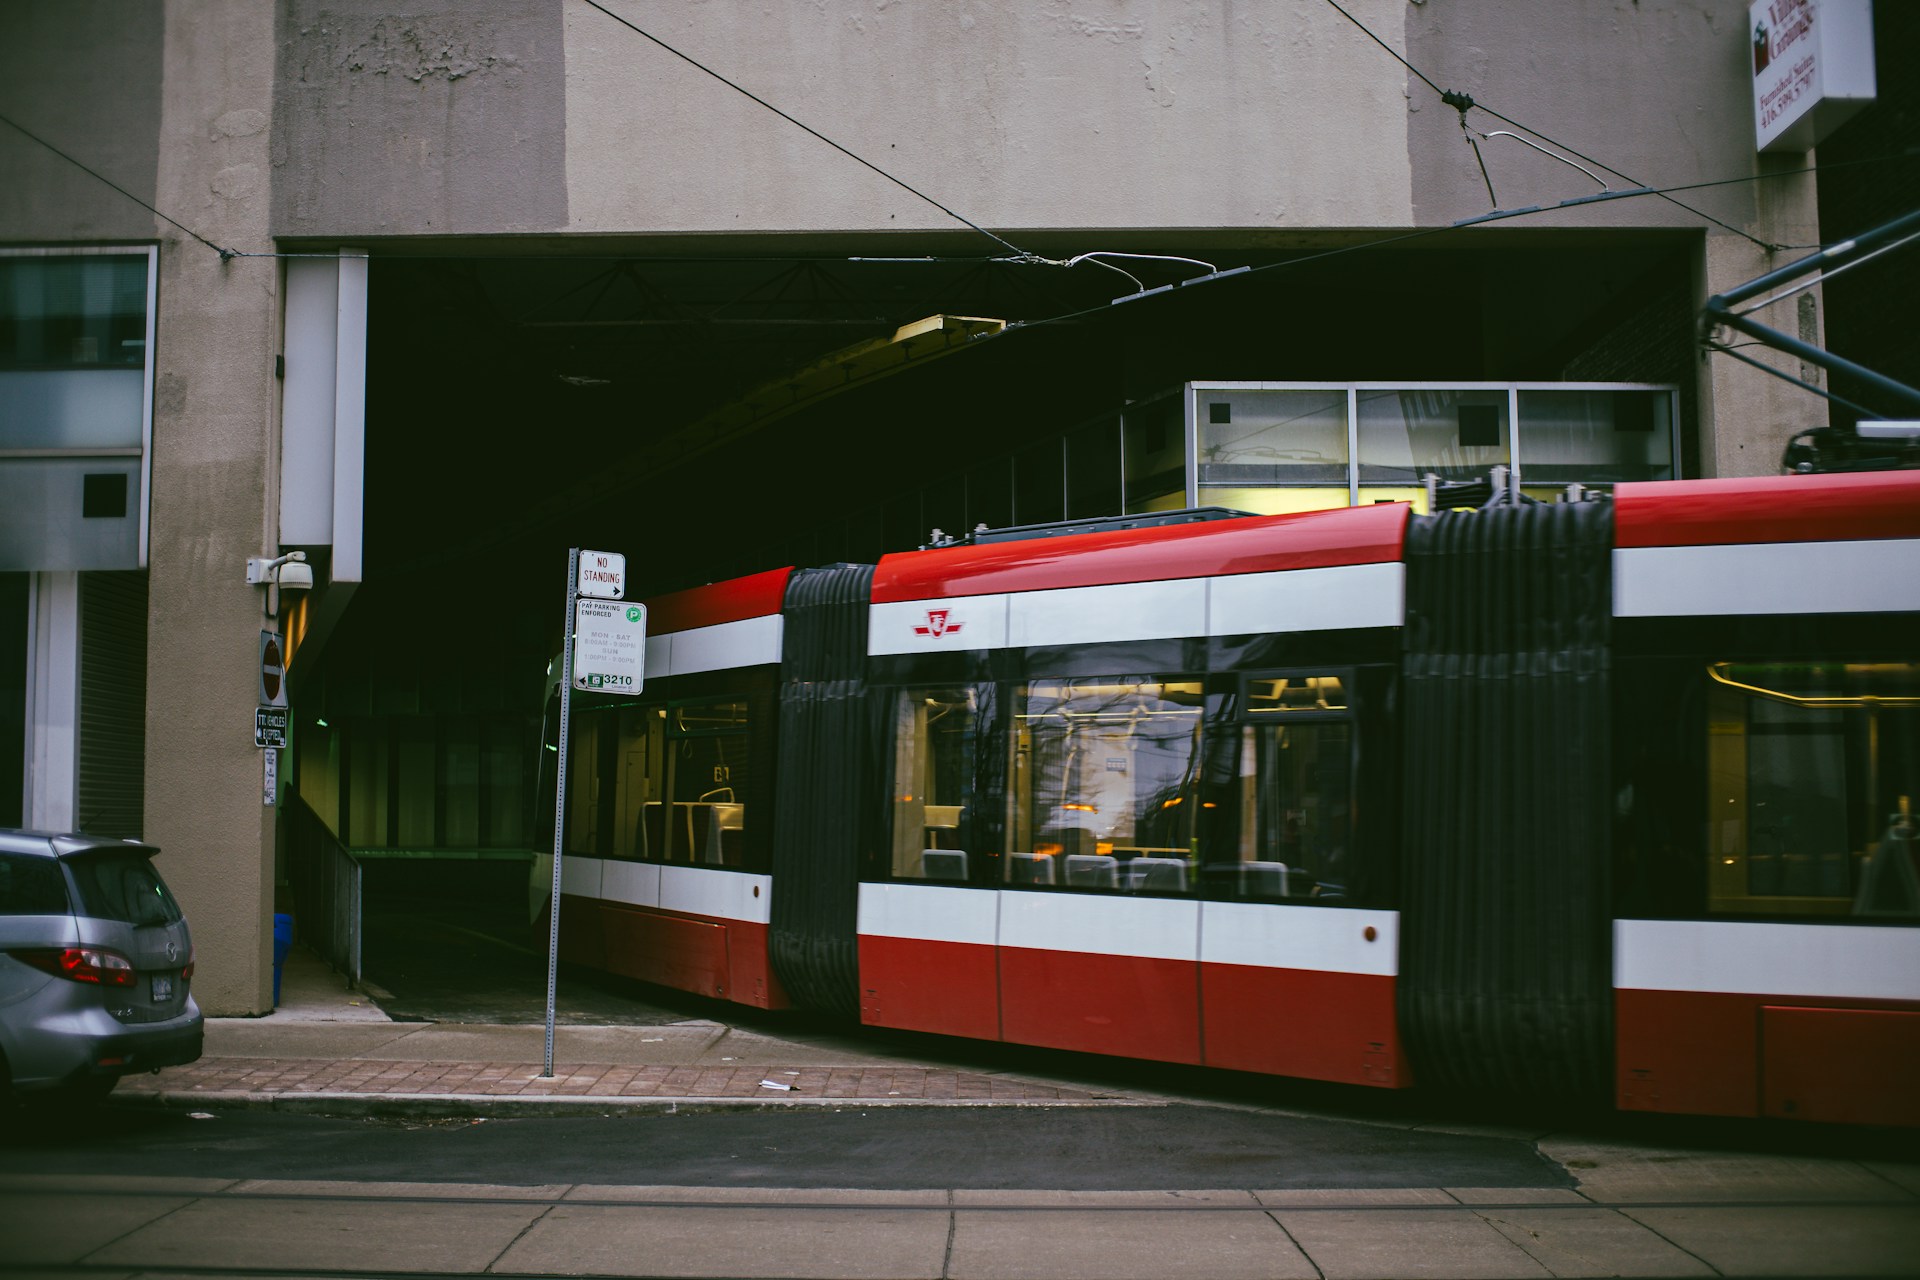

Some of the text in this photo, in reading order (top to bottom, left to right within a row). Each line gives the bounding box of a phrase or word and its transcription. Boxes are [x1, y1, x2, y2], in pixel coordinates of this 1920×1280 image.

[597, 557, 608, 568] NO
[584, 569, 620, 584] STANDING
[595, 603, 621, 612] PARKING
[581, 609, 612, 618] ENFORCED
[591, 631, 609, 639] MON
[616, 633, 631, 641] SAT
[602, 647, 619, 655] SUN
[604, 674, 633, 686] 3210
